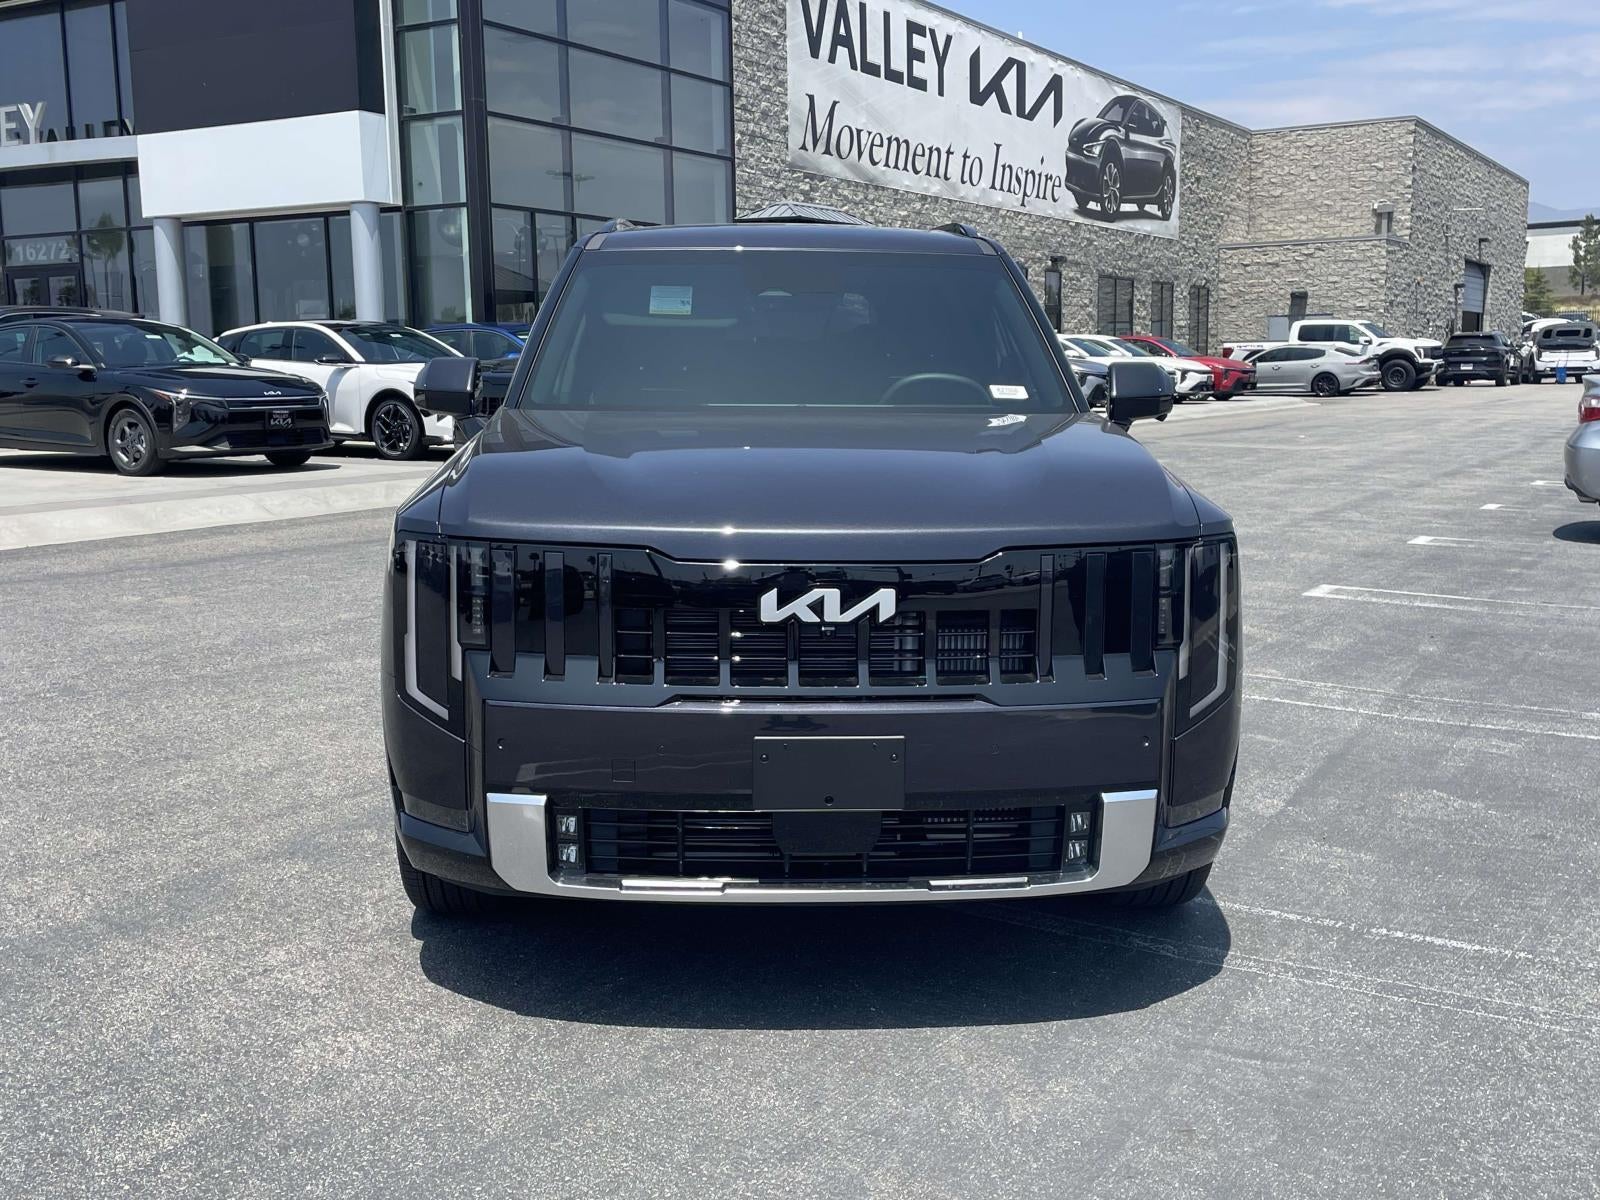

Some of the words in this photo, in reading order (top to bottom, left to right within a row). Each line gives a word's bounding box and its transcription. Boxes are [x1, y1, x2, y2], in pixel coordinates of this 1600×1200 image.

[801, 0, 953, 97] VALLEY
[969, 45, 1063, 128] KIA
[798, 93, 954, 182] Movement
[959, 147, 984, 187] to
[989, 142, 1062, 207] Inspire
[15, 242, 70, 262] 16272
[760, 587, 896, 623] KIA
